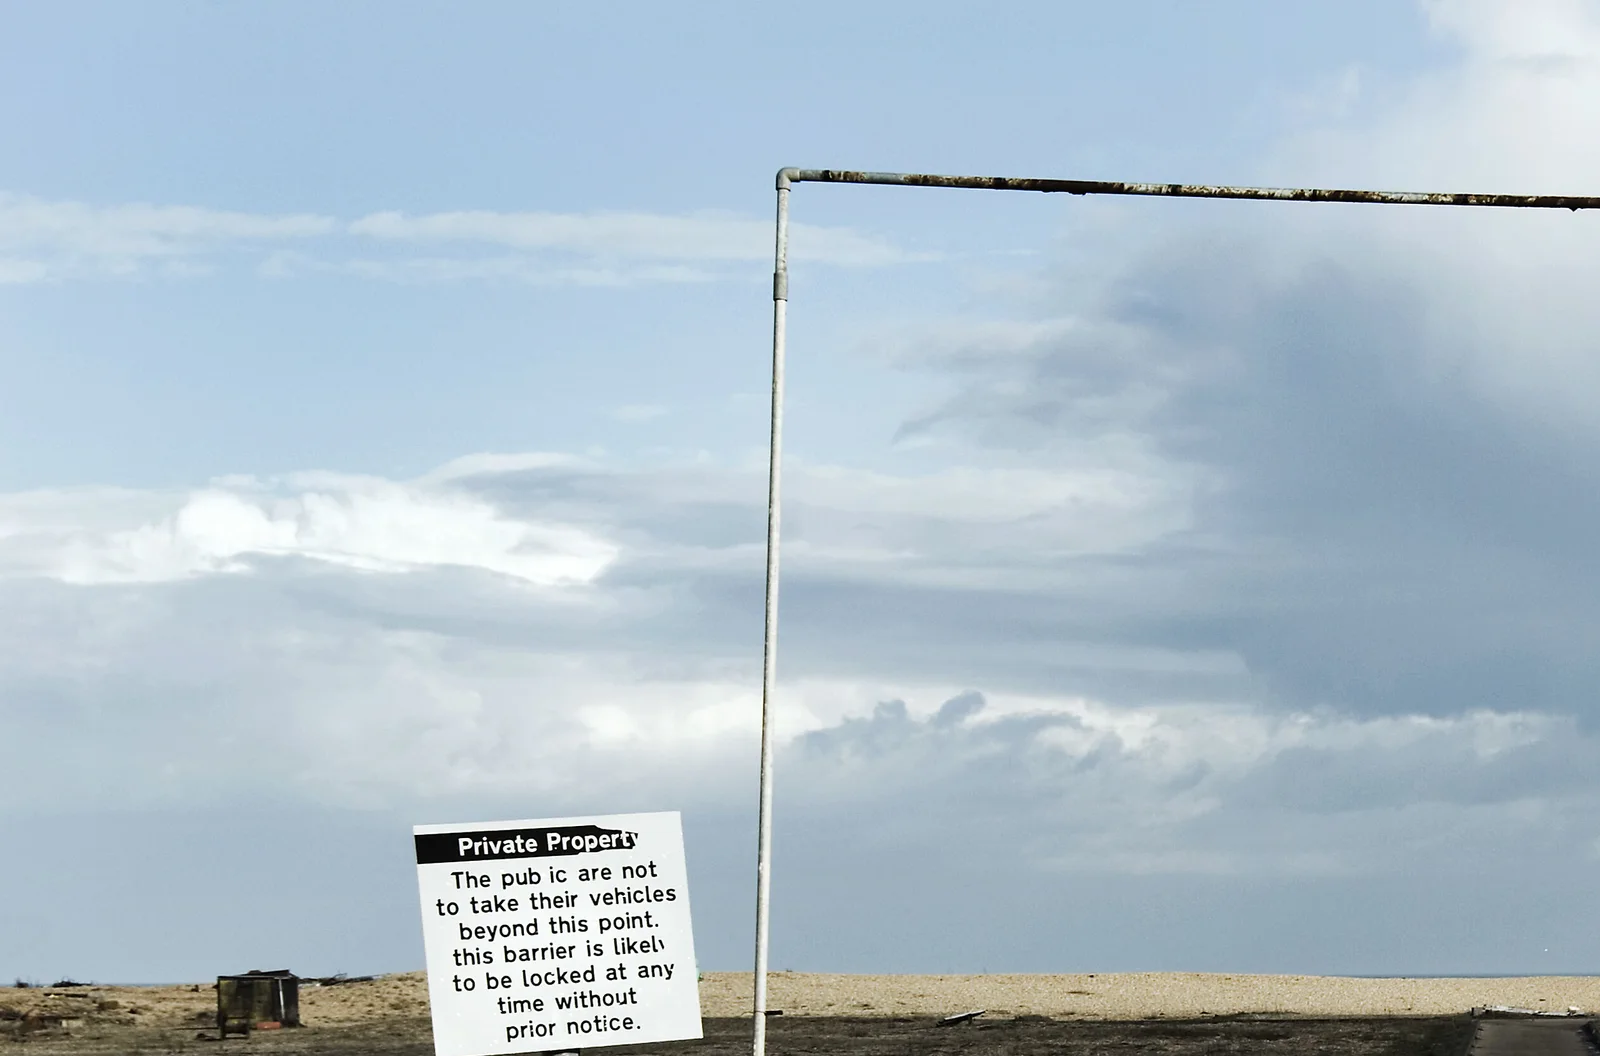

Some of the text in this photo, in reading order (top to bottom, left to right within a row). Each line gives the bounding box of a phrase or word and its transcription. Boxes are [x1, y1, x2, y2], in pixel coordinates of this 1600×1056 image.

[458, 837, 538, 856] Private
[451, 861, 657, 889] The pubic are not
[436, 886, 676, 916] to take their vehicles
[460, 911, 658, 942] beyond this point.
[453, 948, 493, 966] this
[504, 943, 575, 962] barrier
[586, 940, 603, 956] is
[453, 963, 674, 991] to be locked at any
[497, 988, 637, 1014] time without
[507, 1015, 640, 1042] prior notice.
